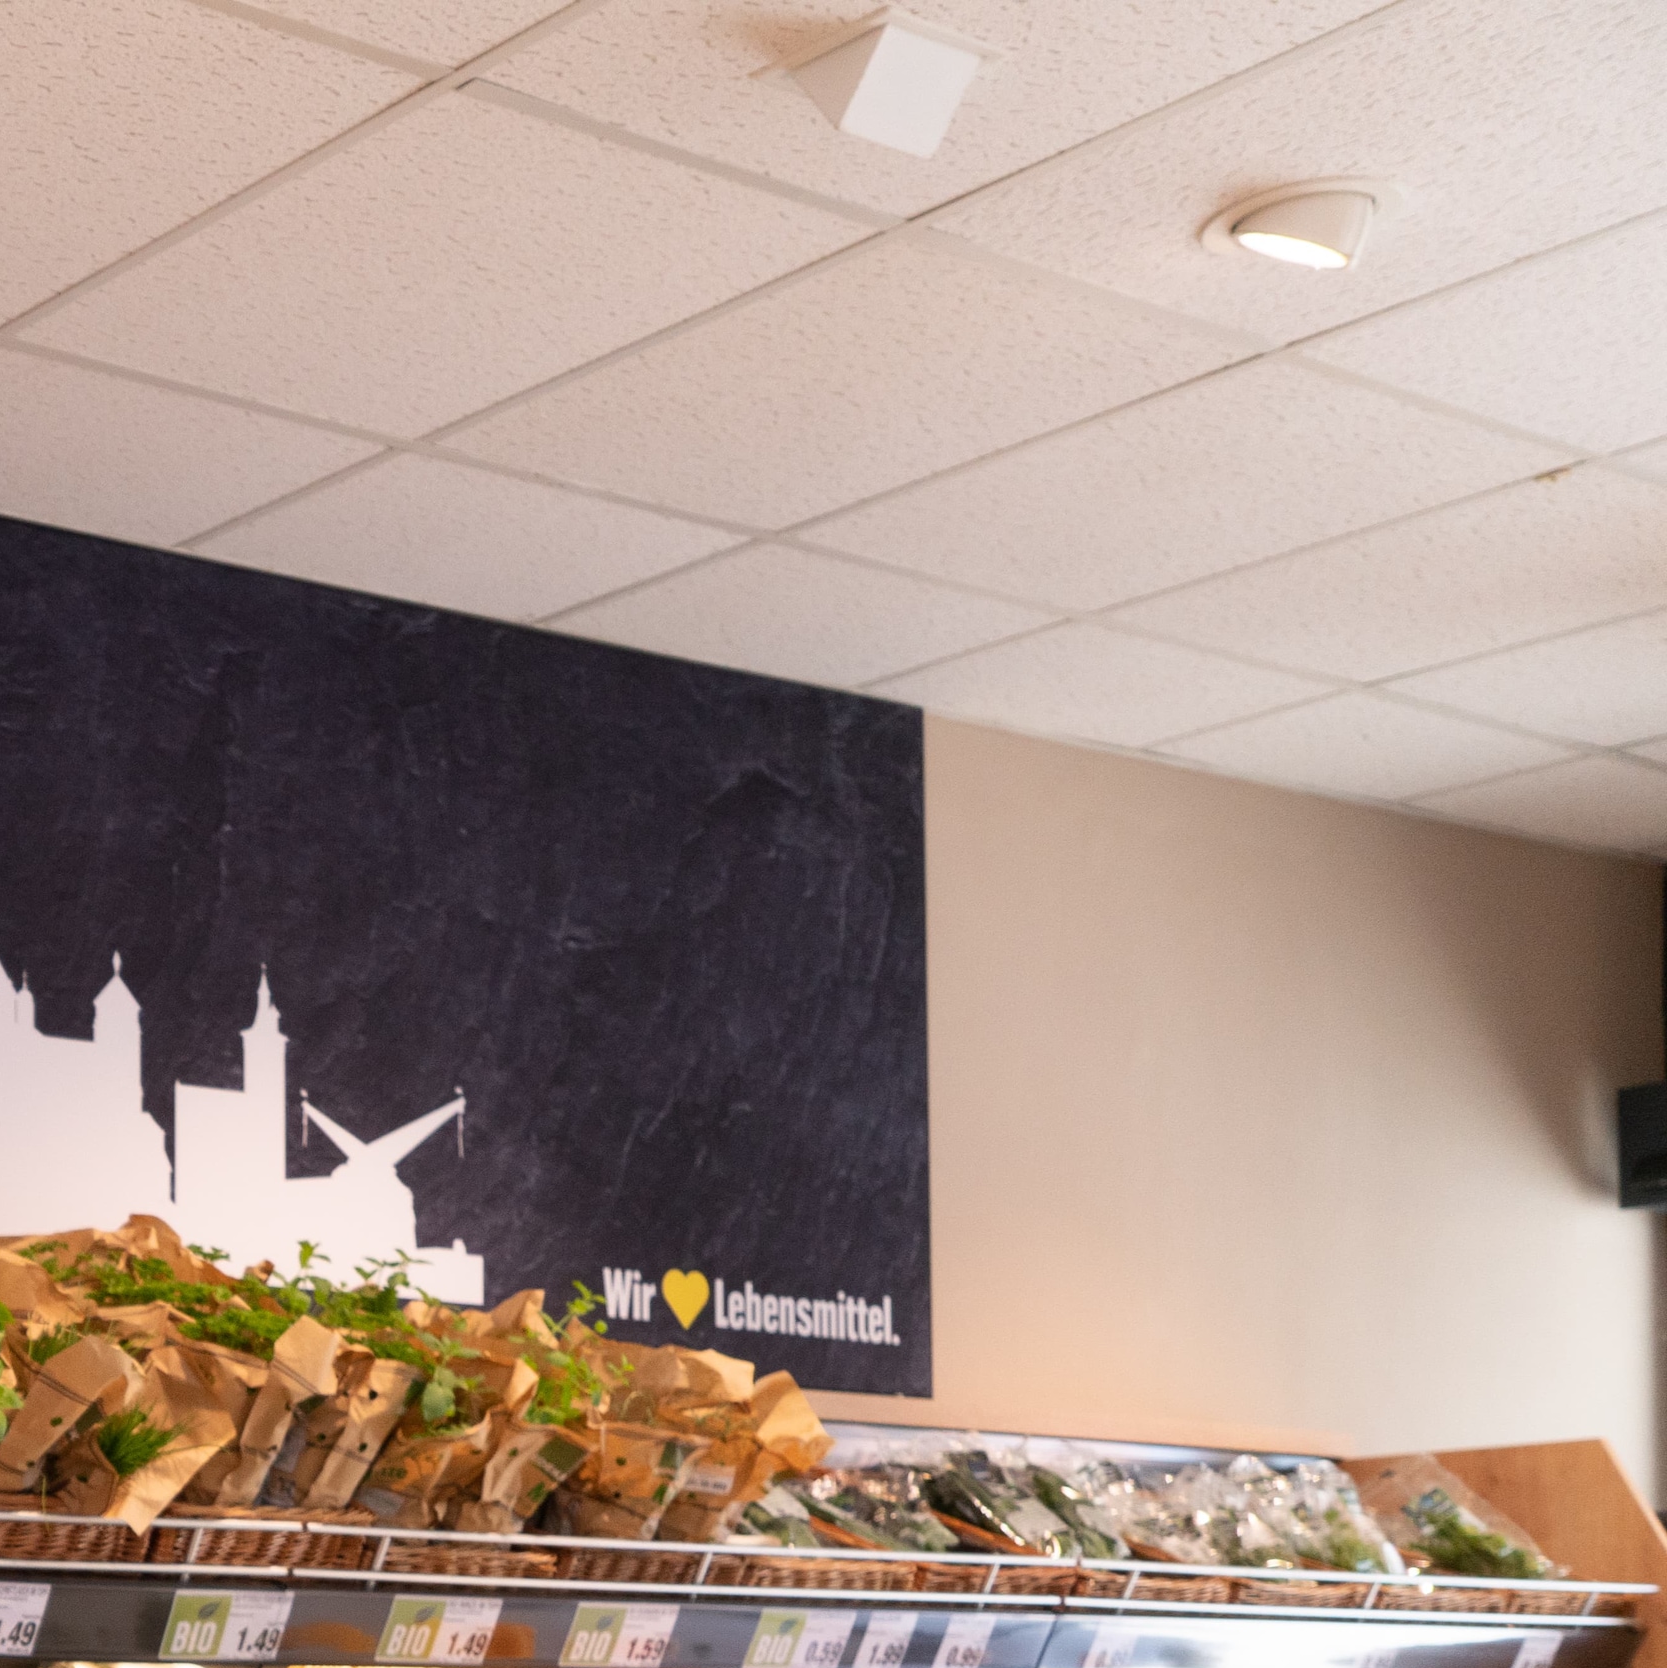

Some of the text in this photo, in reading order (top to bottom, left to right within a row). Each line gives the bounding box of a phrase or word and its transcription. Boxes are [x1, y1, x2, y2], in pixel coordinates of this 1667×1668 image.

[602, 1266, 901, 1346] Wir Lebensmittel.
[170, 1620, 217, 1654] BIO
[236, 1627, 281, 1653] 1.49
[385, 1624, 432, 1657] BIO
[446, 1631, 489, 1657] 1.49
[568, 1630, 613, 1663] BIO
[752, 1635, 794, 1668] BIO
